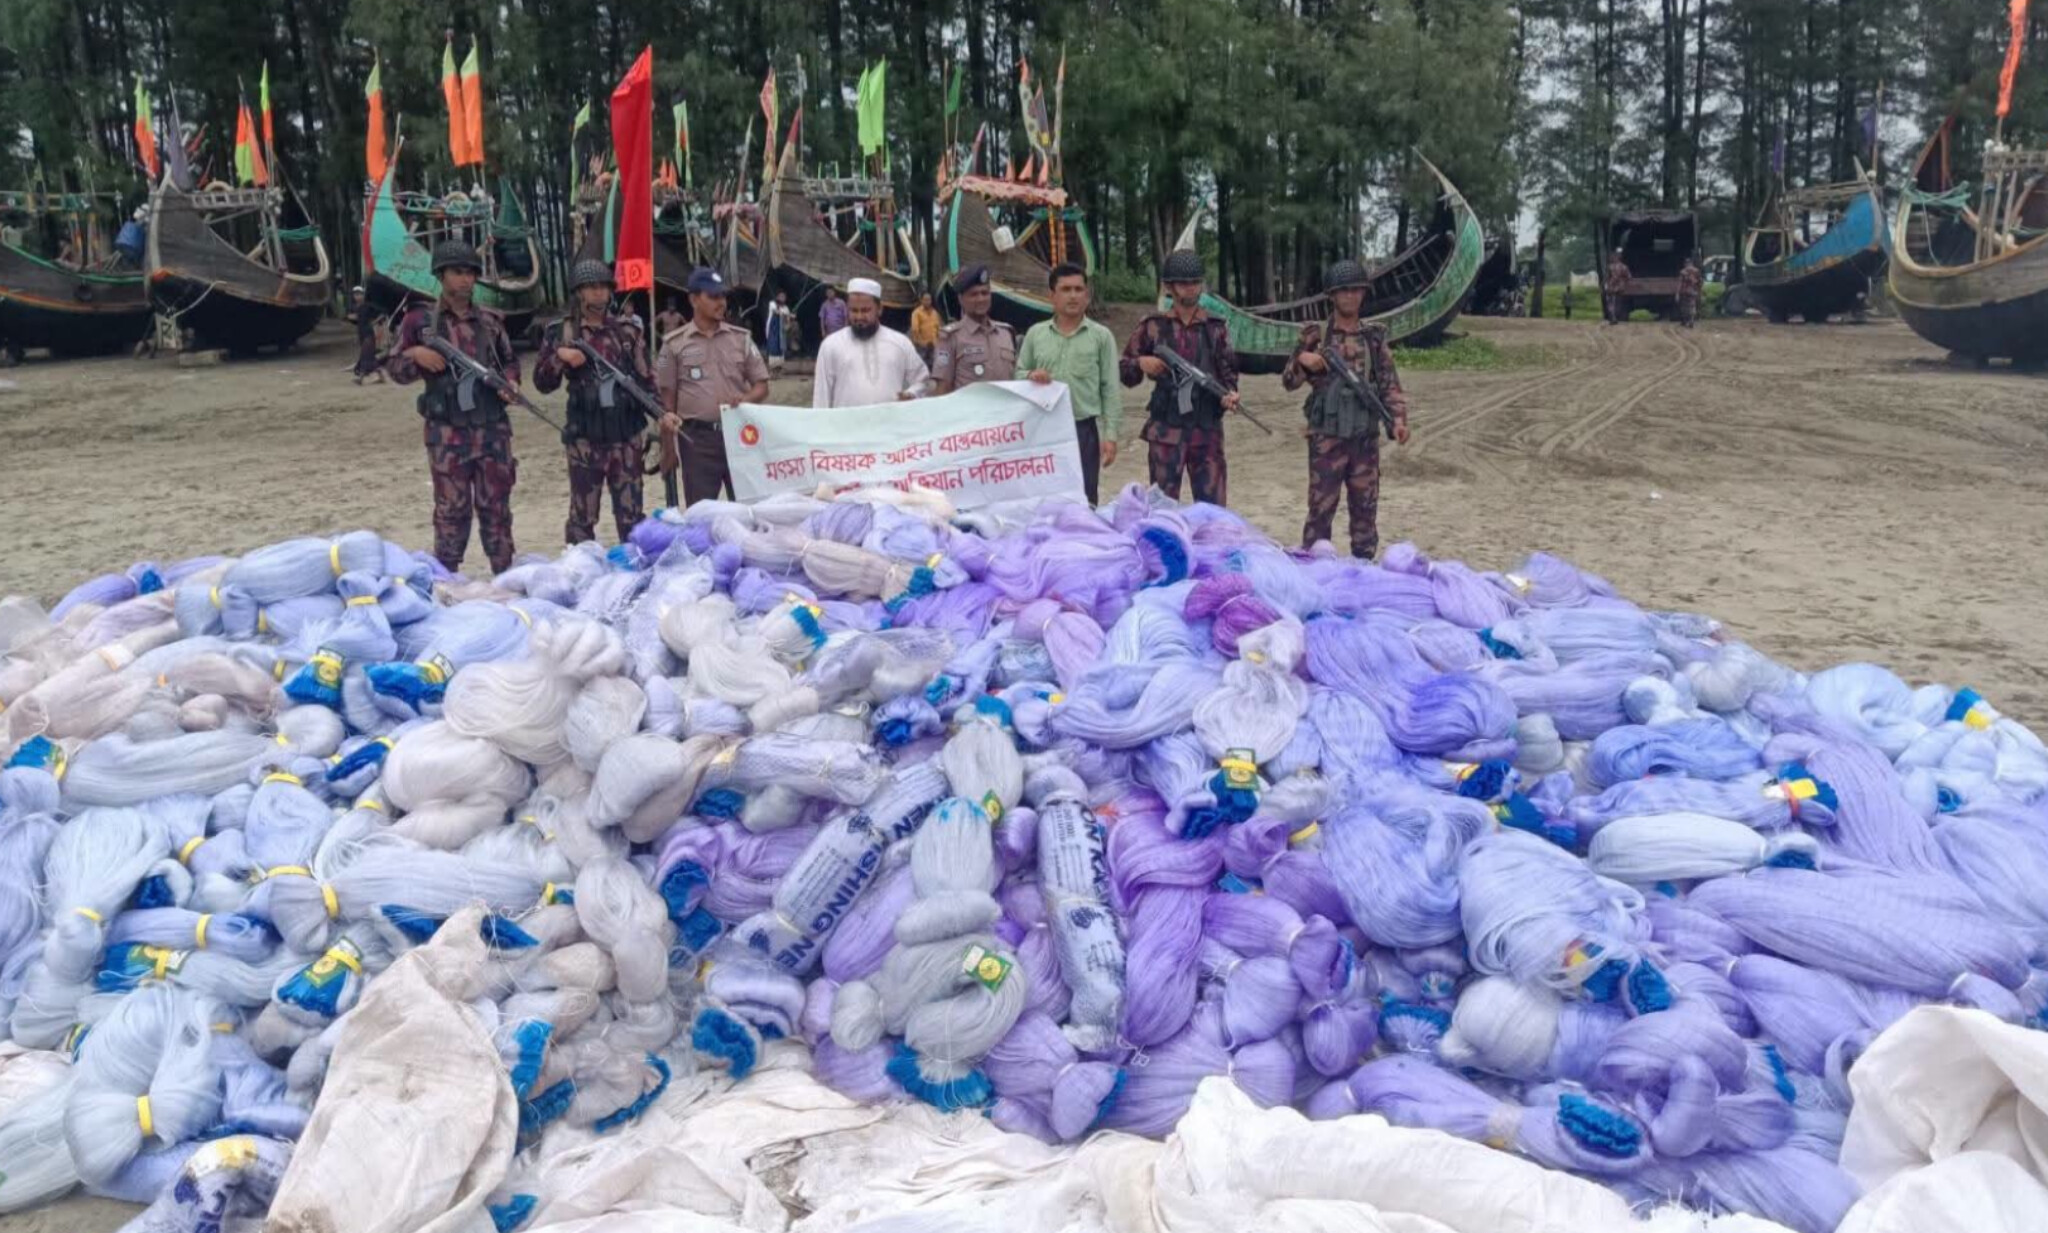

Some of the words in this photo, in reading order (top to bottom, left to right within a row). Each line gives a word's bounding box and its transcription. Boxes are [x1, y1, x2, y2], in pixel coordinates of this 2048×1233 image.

[765, 456, 805, 480] মৎস্য
[810, 450, 876, 474] বিষয়ক
[882, 440, 933, 465] আইন
[939, 421, 1025, 453] বাস্তবায়নে
[968, 453, 1056, 485] পরিচালনা
[811, 840, 886, 934] ISHING
[775, 935, 815, 968] NE
